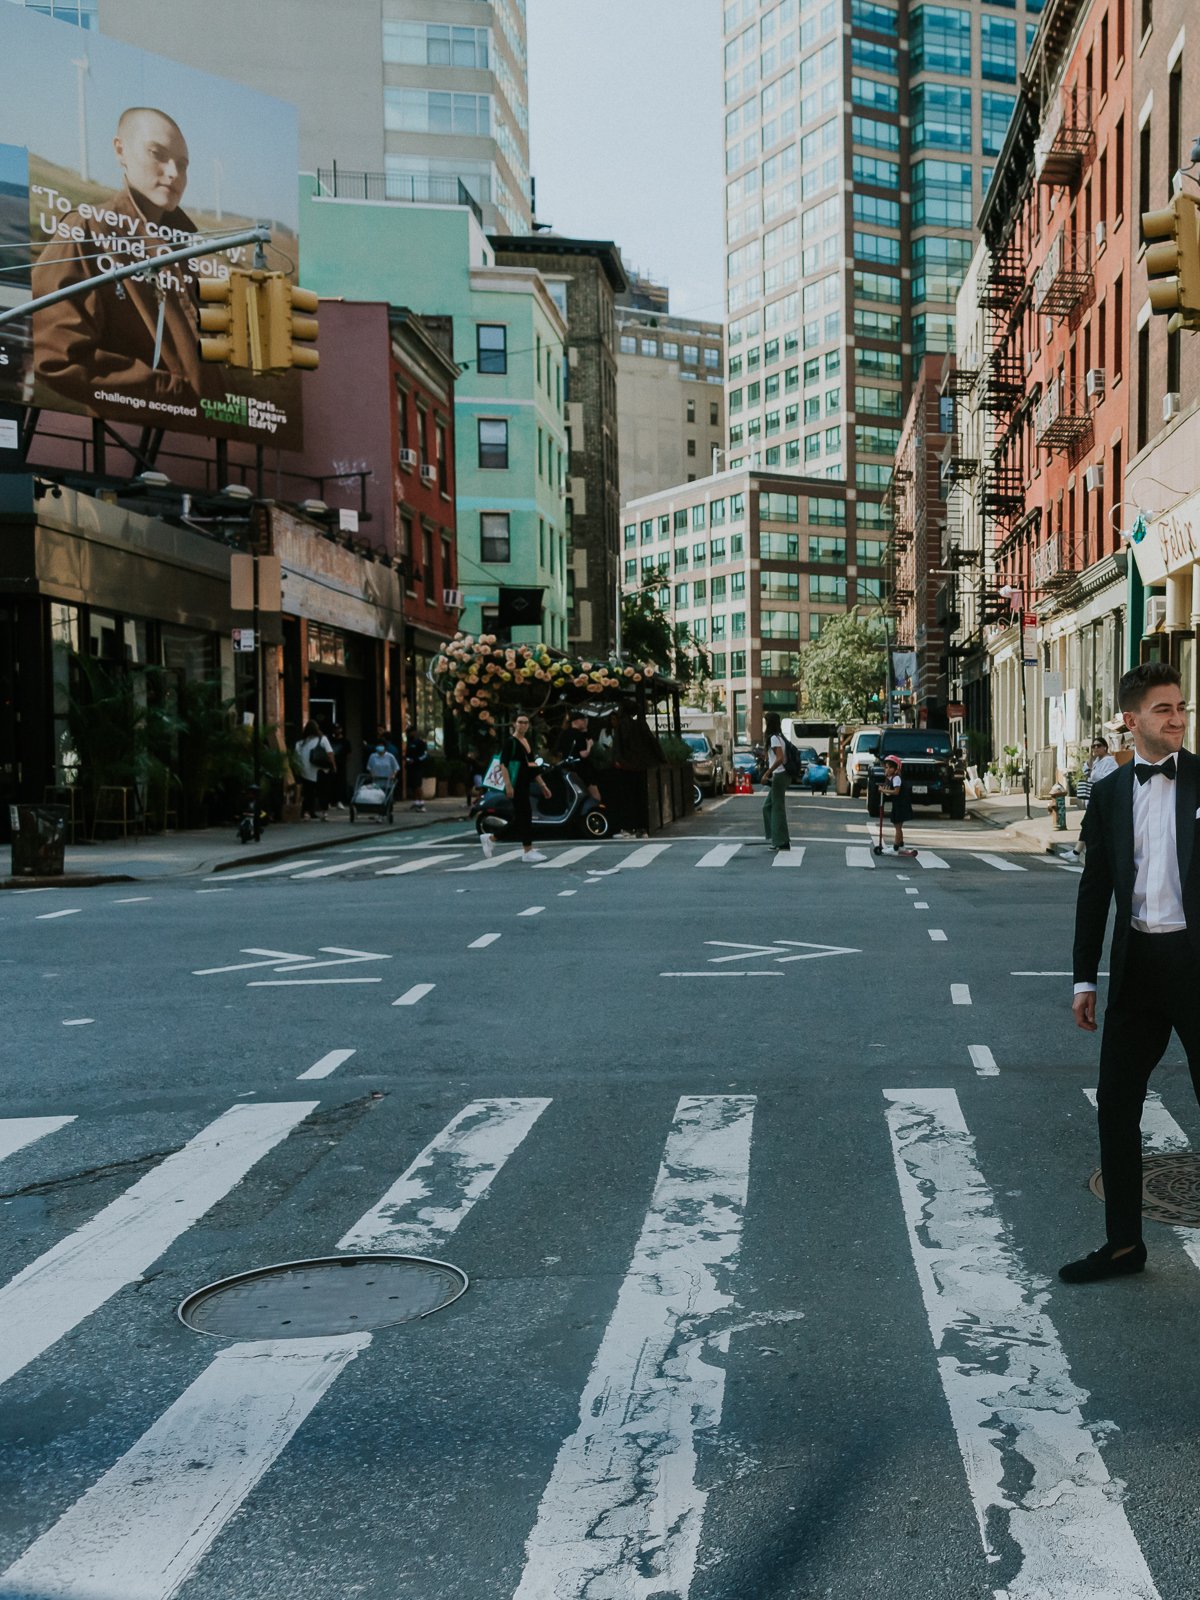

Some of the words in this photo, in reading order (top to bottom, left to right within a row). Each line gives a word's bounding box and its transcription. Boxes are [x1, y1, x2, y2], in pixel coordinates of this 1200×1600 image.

[78, 203, 140, 236] every
[40, 212, 86, 242] Use
[91, 230, 150, 260] wind.
[94, 390, 147, 408] challenge
[148, 401, 198, 418] accepted
[259, 411, 287, 424] years
